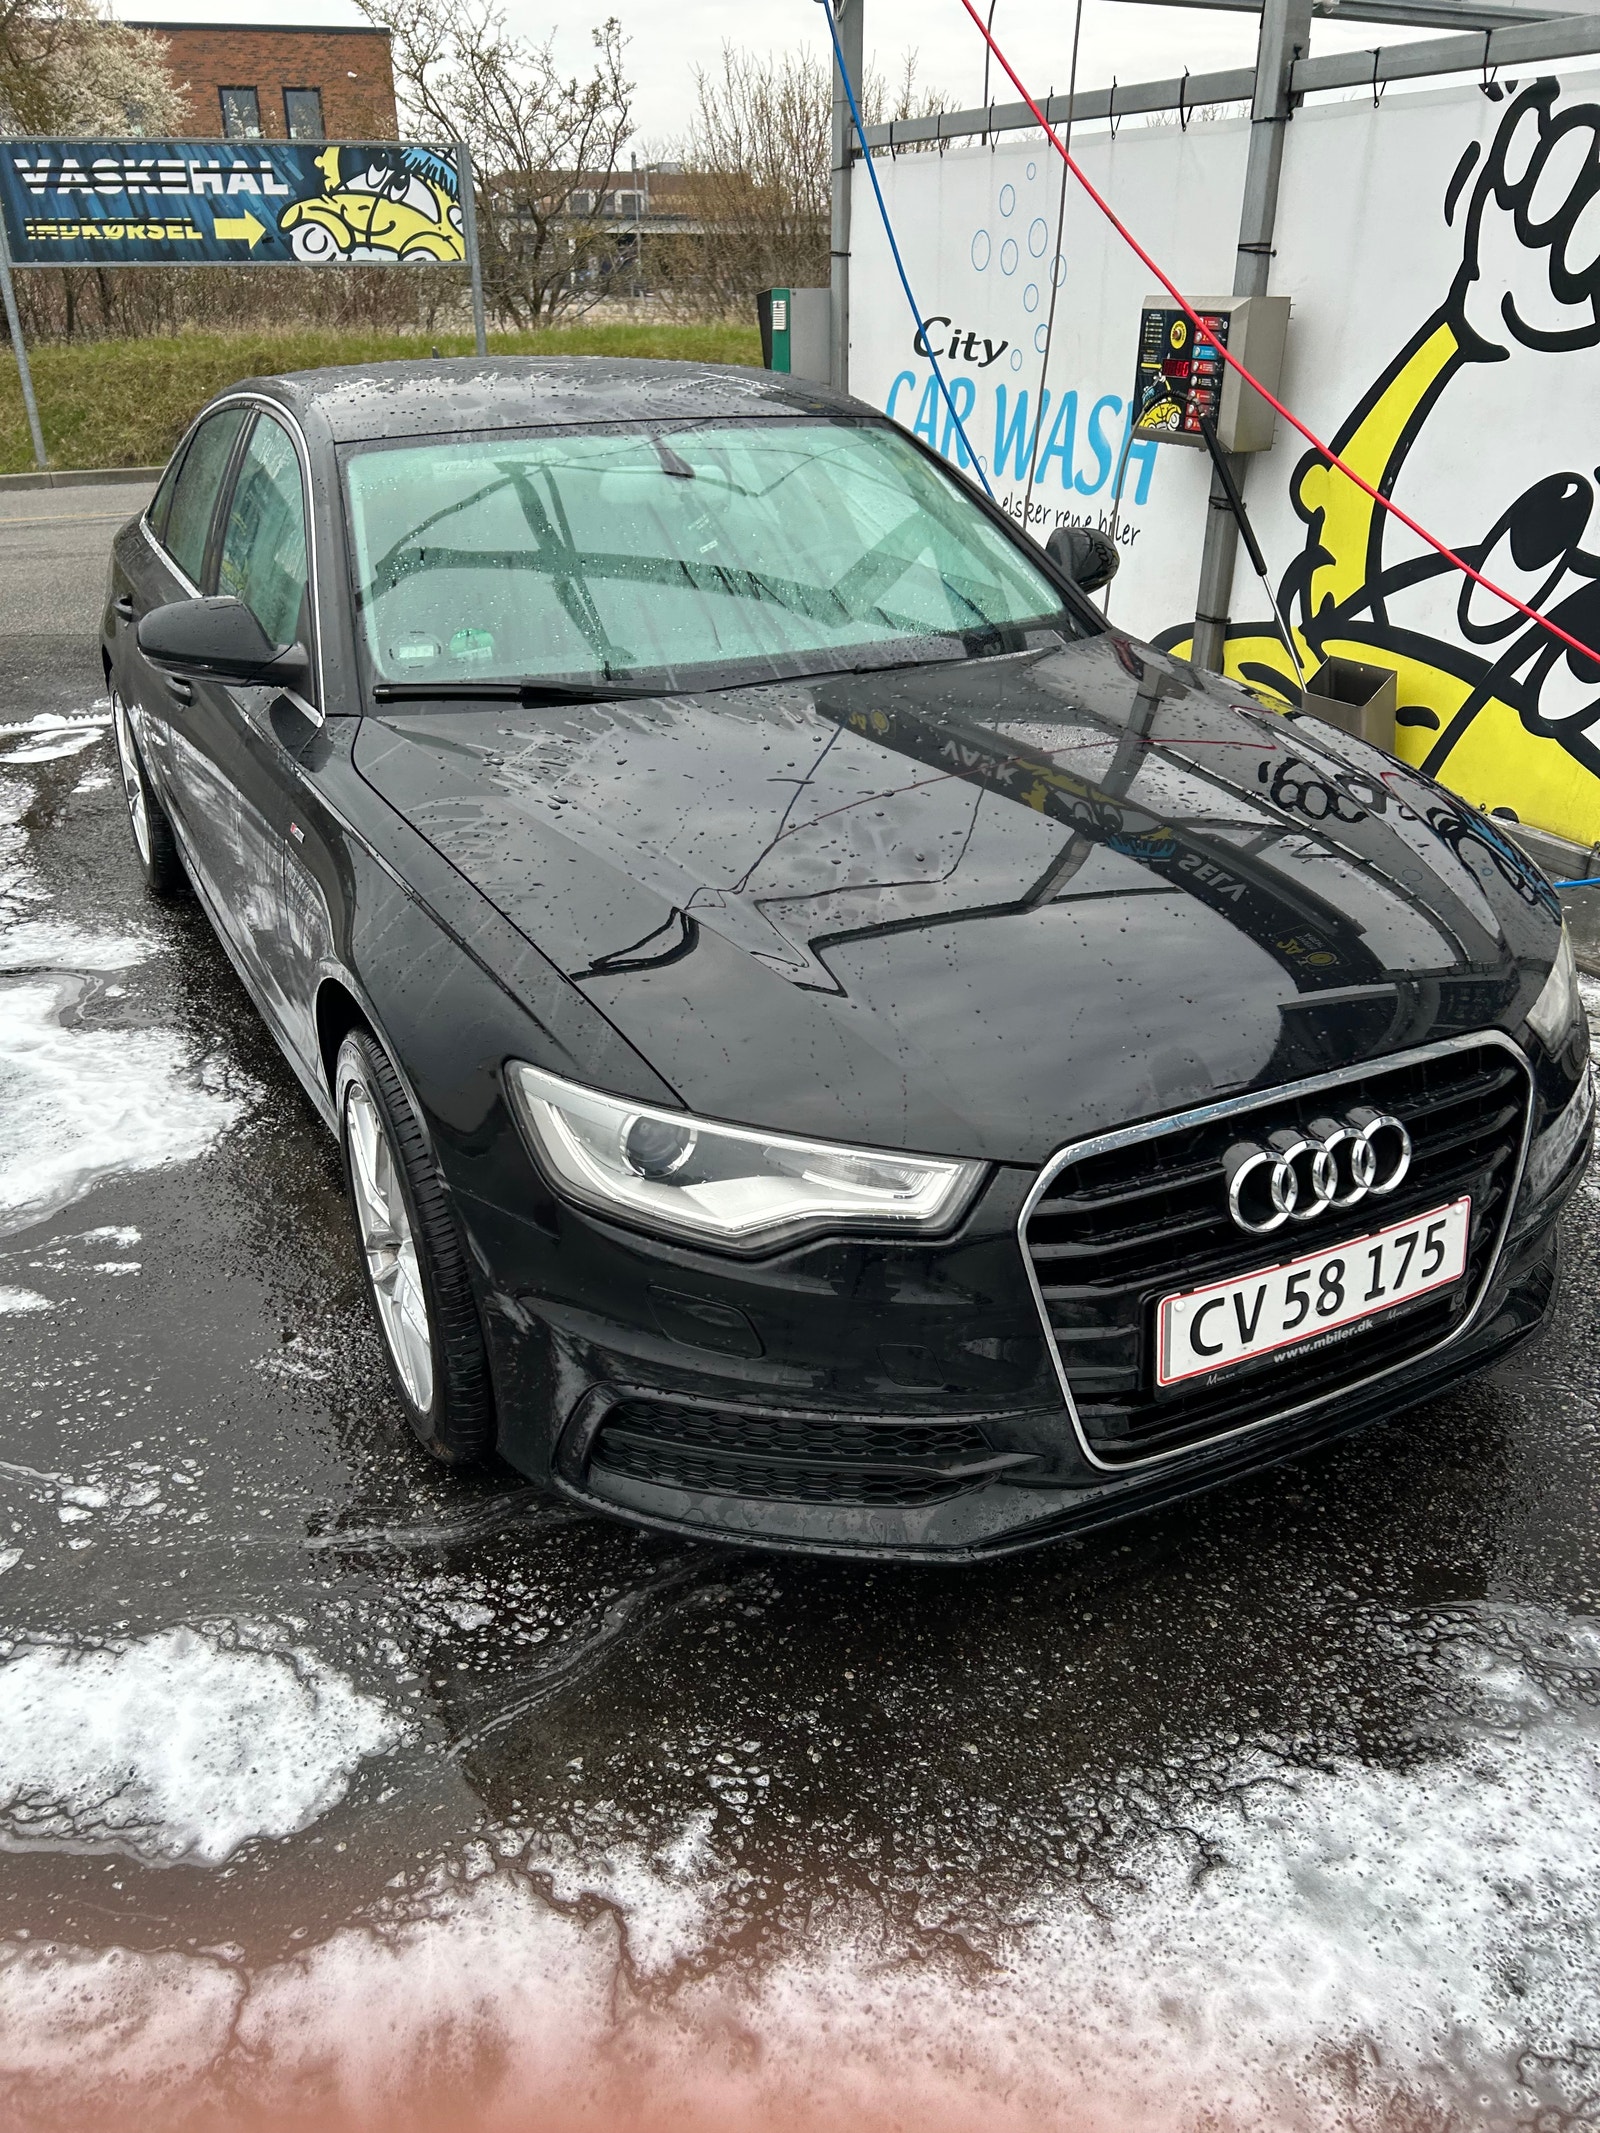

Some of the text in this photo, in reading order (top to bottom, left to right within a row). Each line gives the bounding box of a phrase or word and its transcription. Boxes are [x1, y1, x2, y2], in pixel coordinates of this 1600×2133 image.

[14, 159, 289, 195] VASKEHAL
[913, 316, 1009, 368] City
[886, 371, 1159, 505] CAR WASH
[1189, 1219, 1447, 1357] CV 58 175
[1273, 1318, 1374, 1364] www.mbiler.dk
